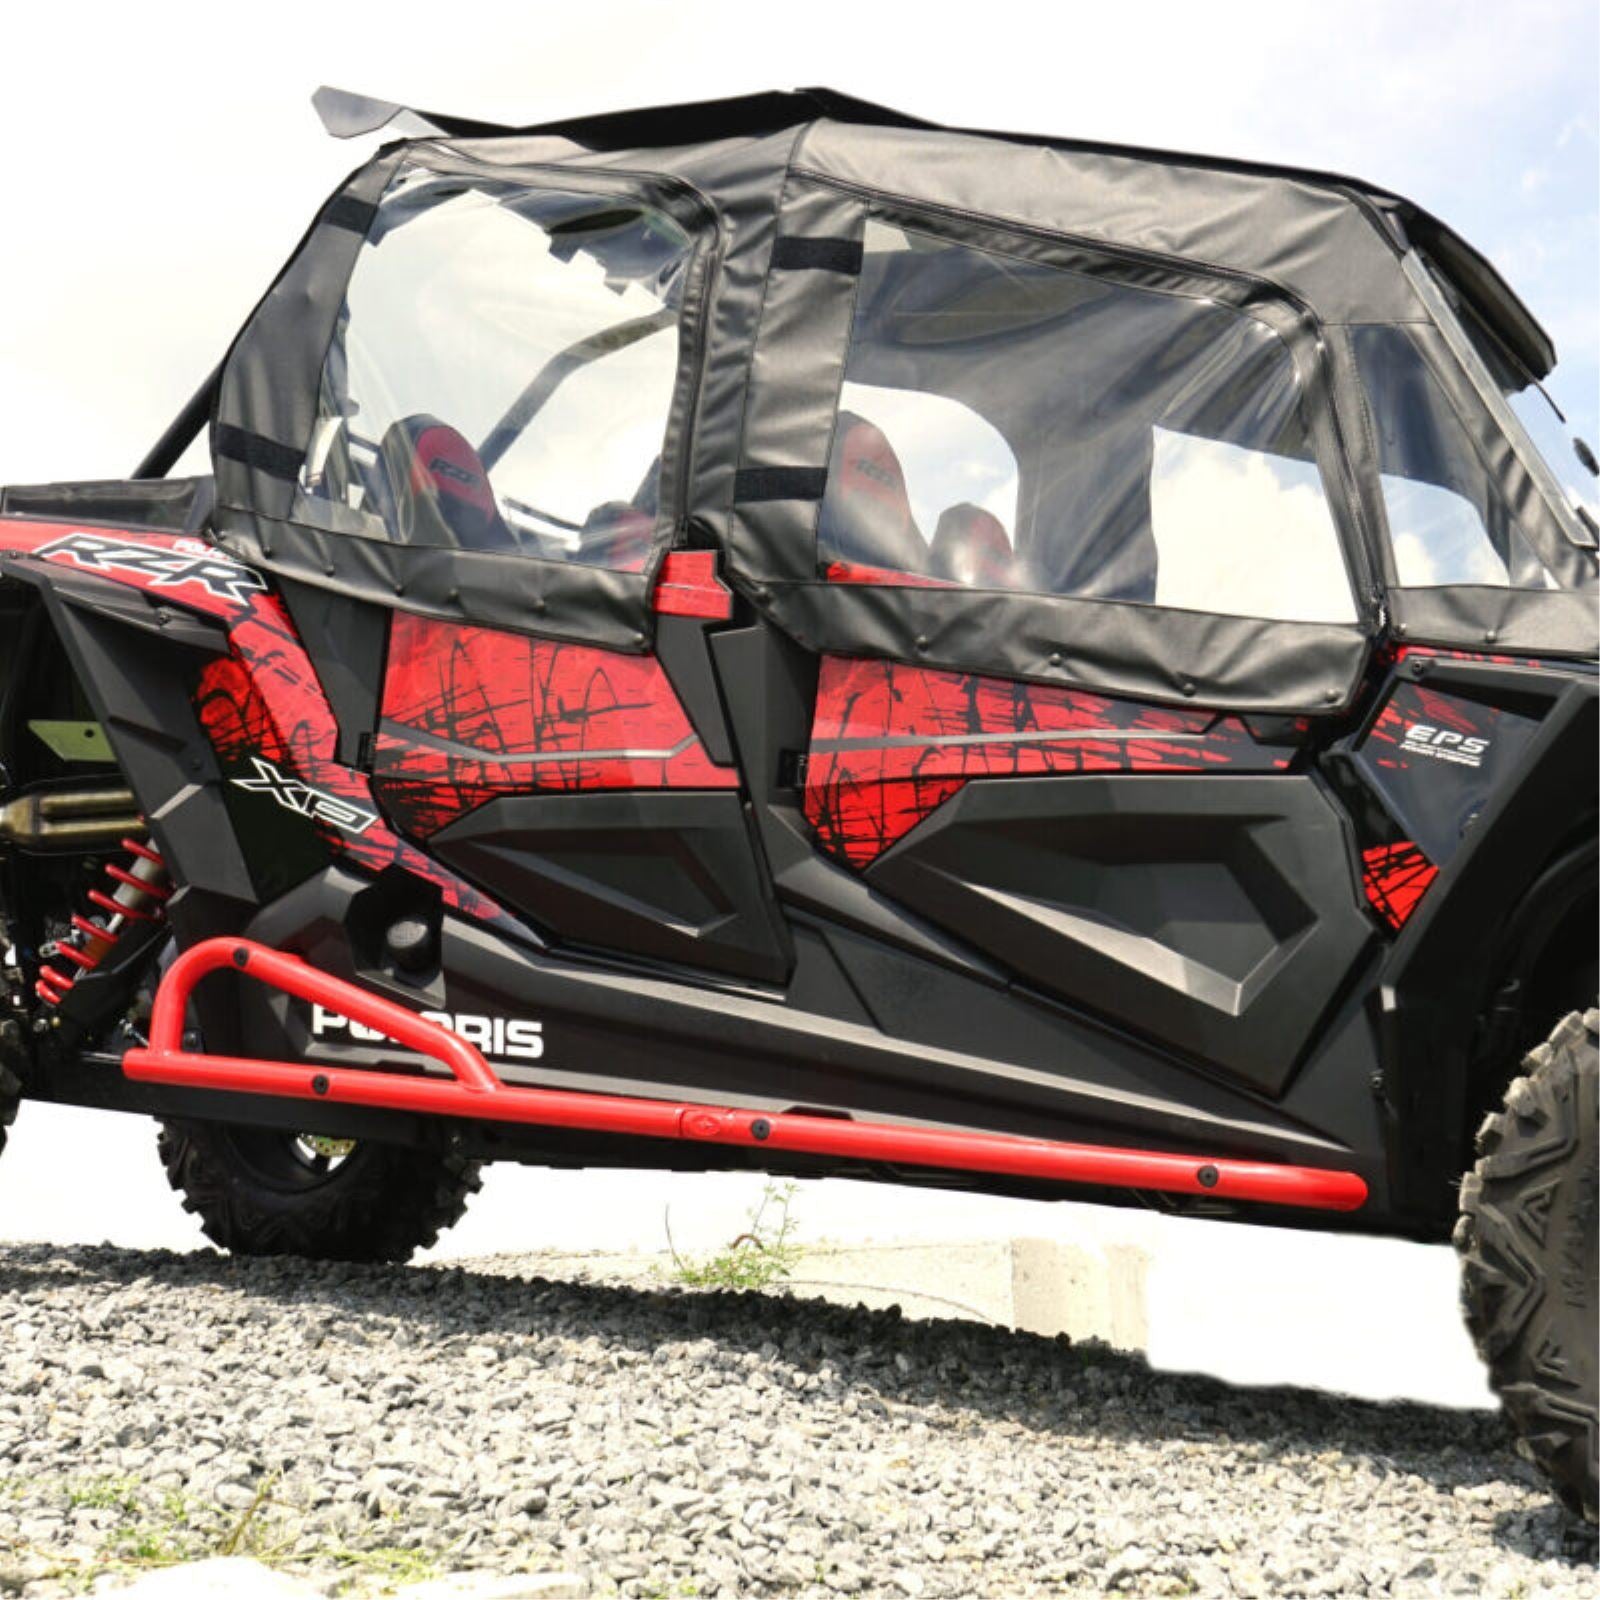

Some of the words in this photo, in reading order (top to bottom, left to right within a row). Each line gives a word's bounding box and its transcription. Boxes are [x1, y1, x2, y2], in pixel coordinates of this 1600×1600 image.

[33, 533, 268, 606] RZR
[1405, 724, 1491, 754] EPS
[230, 756, 378, 833] XP
[312, 1003, 544, 1058] PRIS
